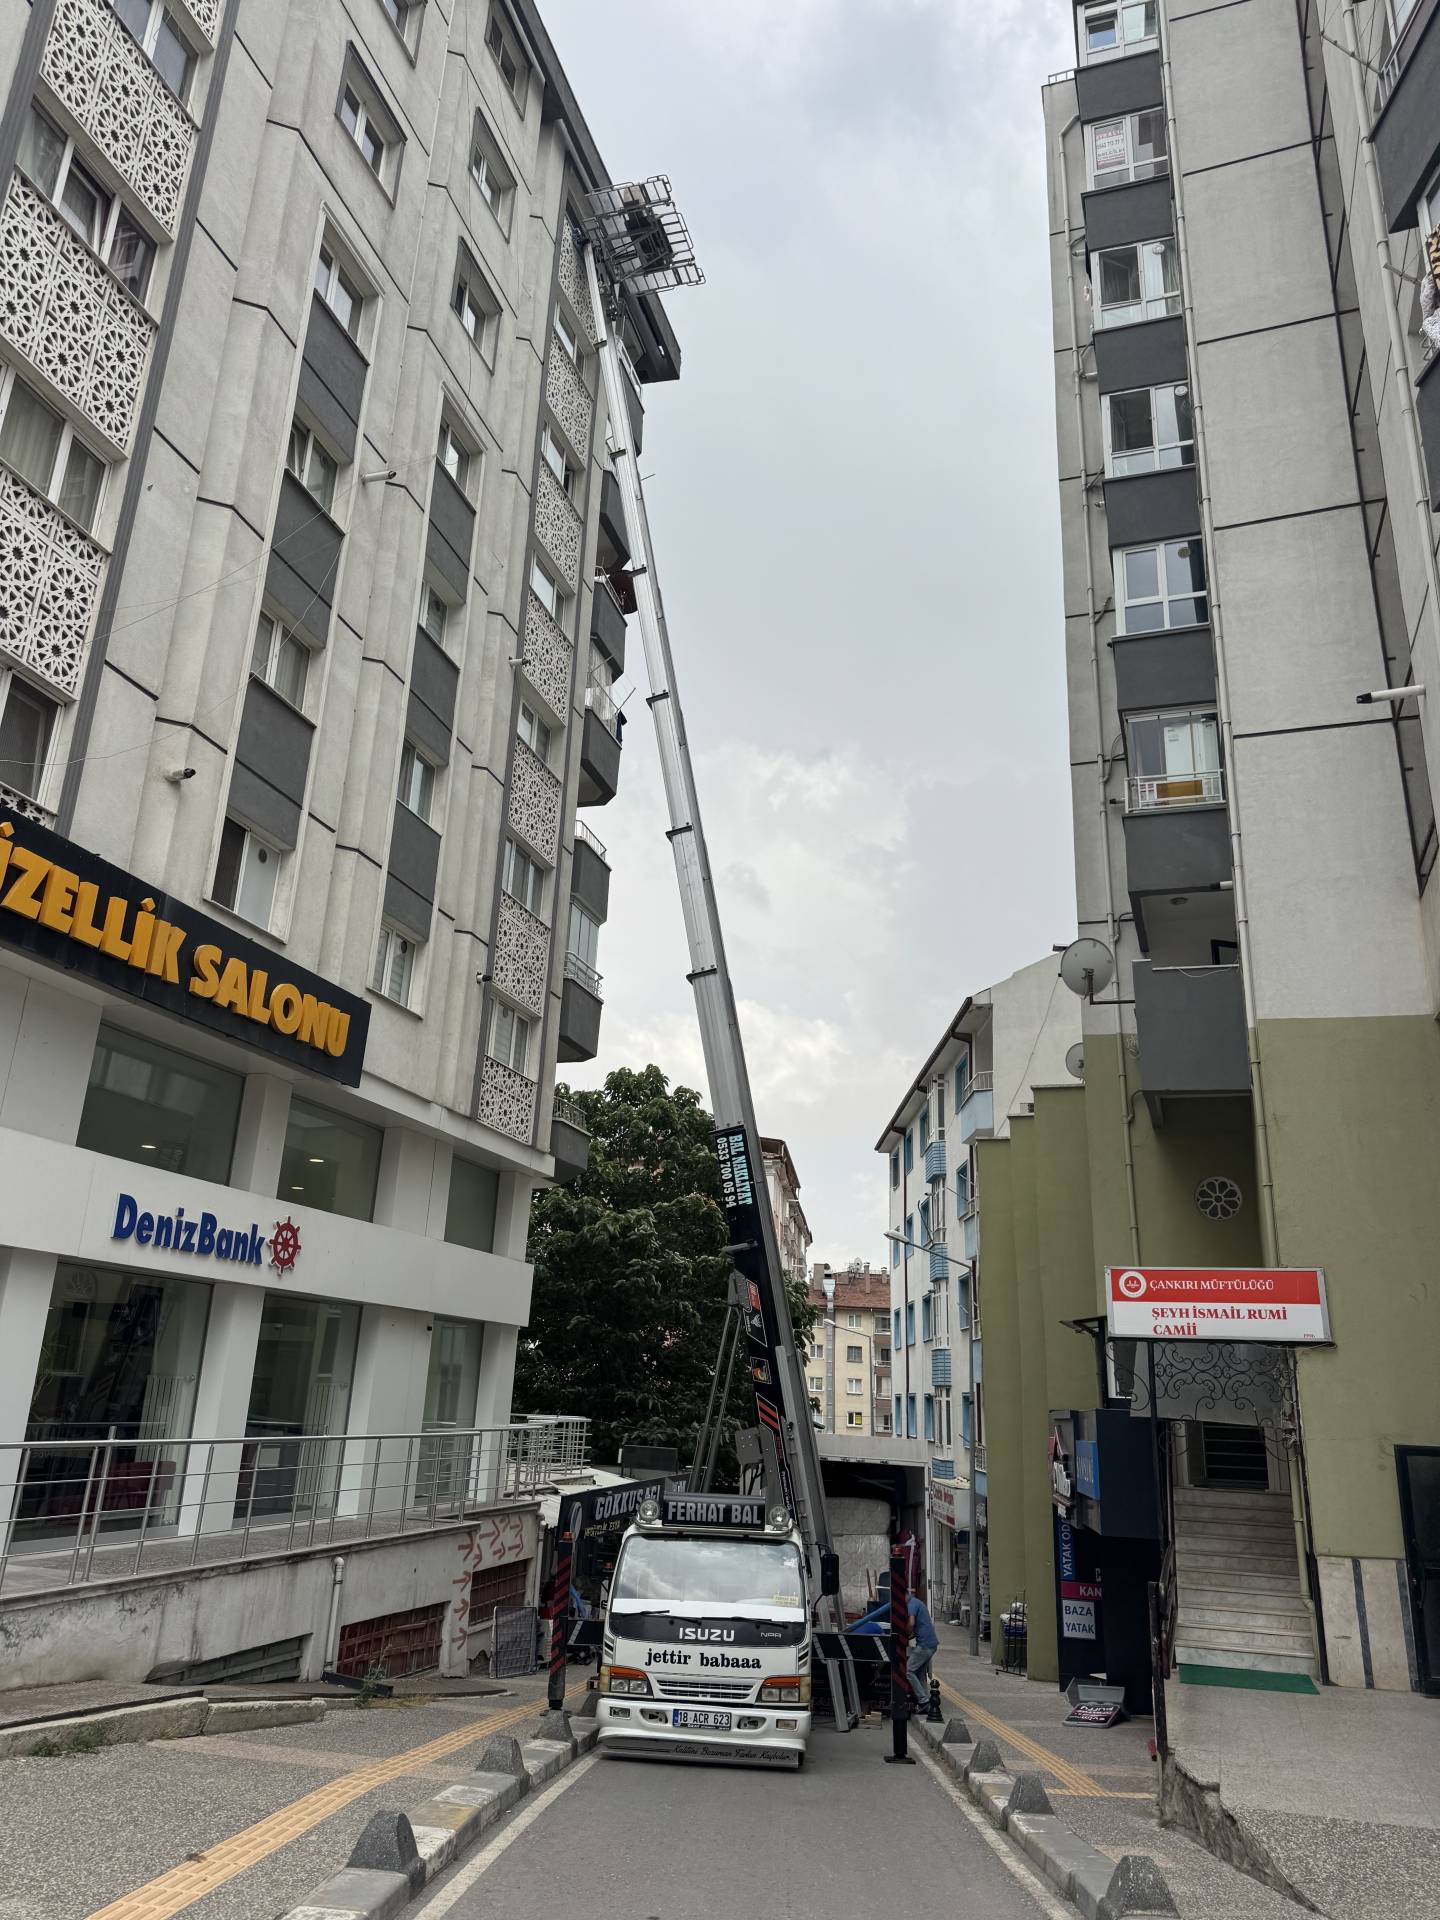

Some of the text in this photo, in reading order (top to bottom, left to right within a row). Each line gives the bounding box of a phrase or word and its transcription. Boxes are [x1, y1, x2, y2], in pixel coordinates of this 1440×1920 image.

[189, 944, 351, 1057] SALONU
[717, 1137, 737, 1208] 0533 700 05 94
[728, 1133, 753, 1205] BAL NAKLİYAT
[111, 1193, 266, 1265] DenizBank
[1150, 1279, 1274, 1292] ÇANKIRI MÜFTÜLÜĞÜ
[1152, 1305, 1288, 1321] ŞEYH İSMAİL RUMİ
[1153, 1323, 1197, 1336] CAMİİ
[667, 1501, 724, 1524] FERHAT
[731, 1502, 762, 1525] BAL
[1062, 1542, 1072, 1577] YATAK
[1064, 1606, 1093, 1617] BAZA
[679, 1627, 735, 1642] ISUZU
[1065, 1622, 1095, 1634] YATAK
[645, 1648, 762, 1669] jettir babaaa
[679, 1711, 730, 1725] 18 ACR 623
